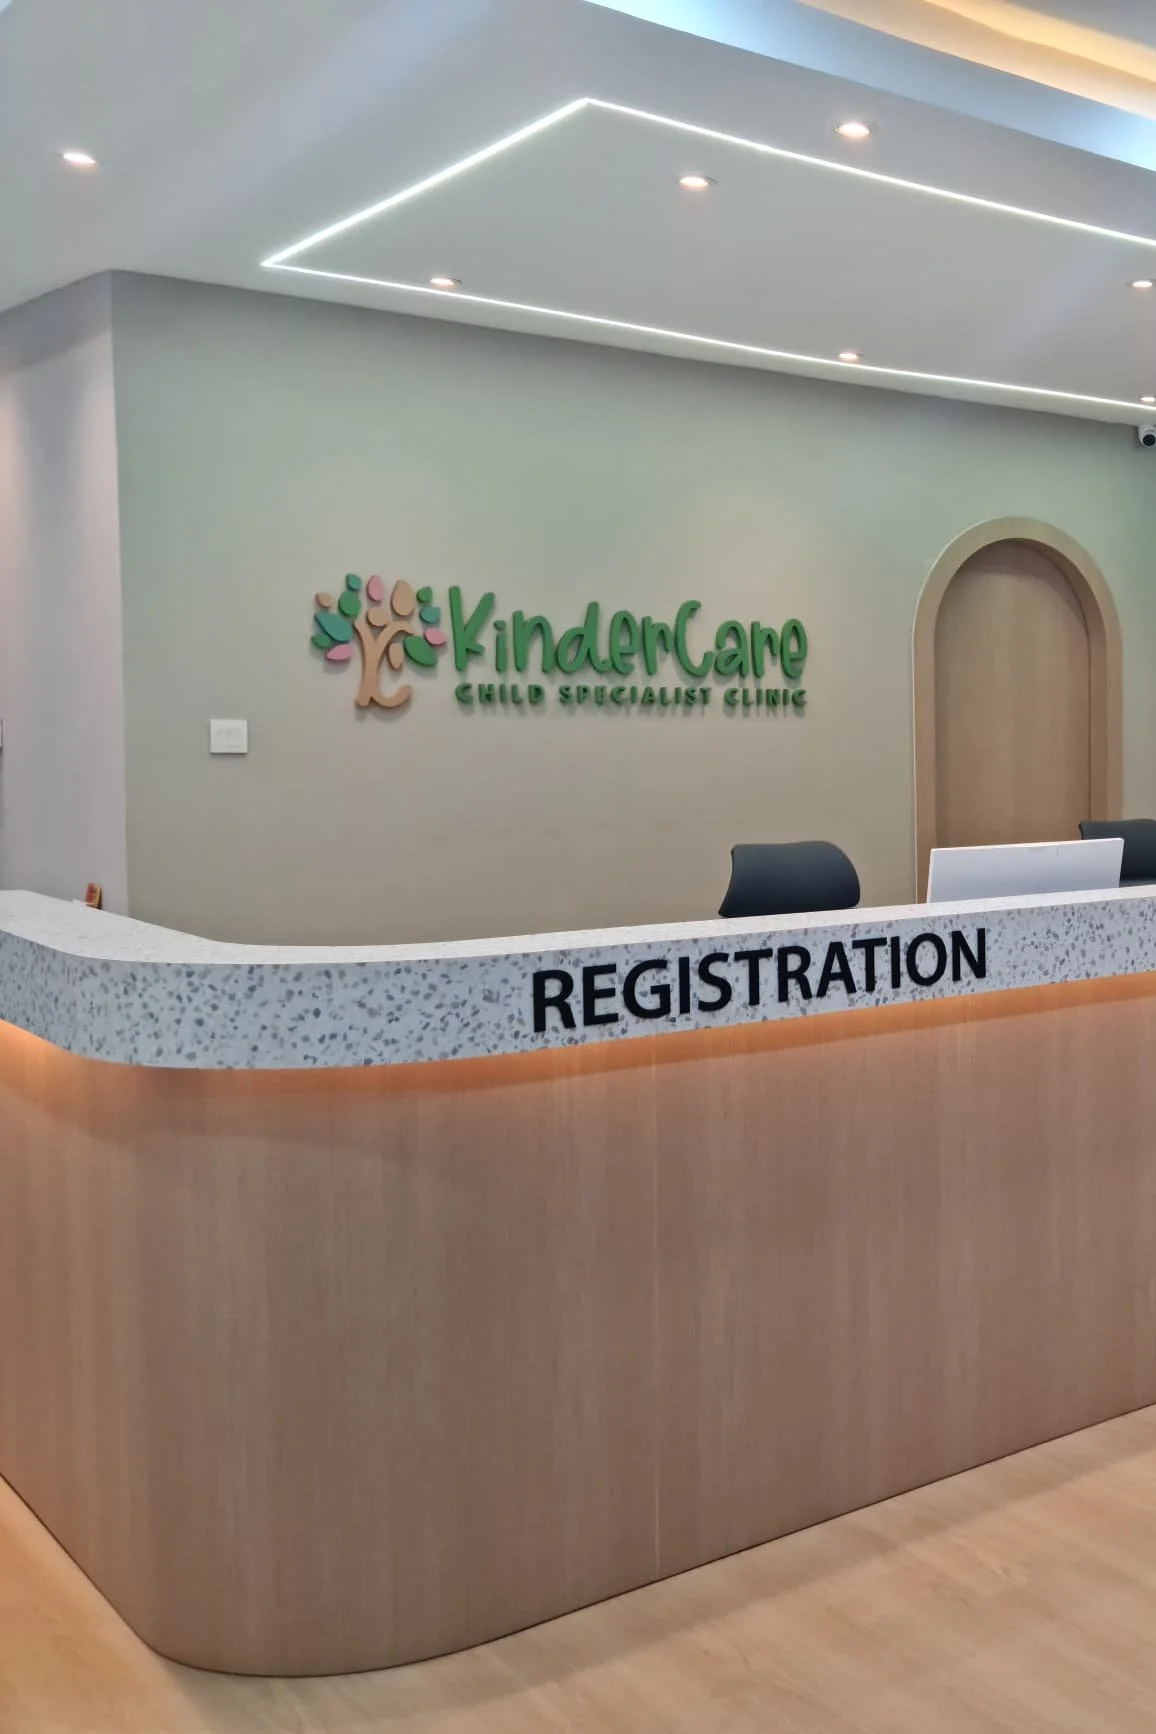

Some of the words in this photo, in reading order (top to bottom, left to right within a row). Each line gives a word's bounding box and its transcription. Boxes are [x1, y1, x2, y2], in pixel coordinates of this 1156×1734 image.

[448, 585, 808, 678] KinderCare
[455, 682, 545, 706] CHILD
[558, 684, 712, 706] SPECIALIST
[723, 687, 808, 707] CLINIC
[532, 927, 987, 1033] REGISTRATION
